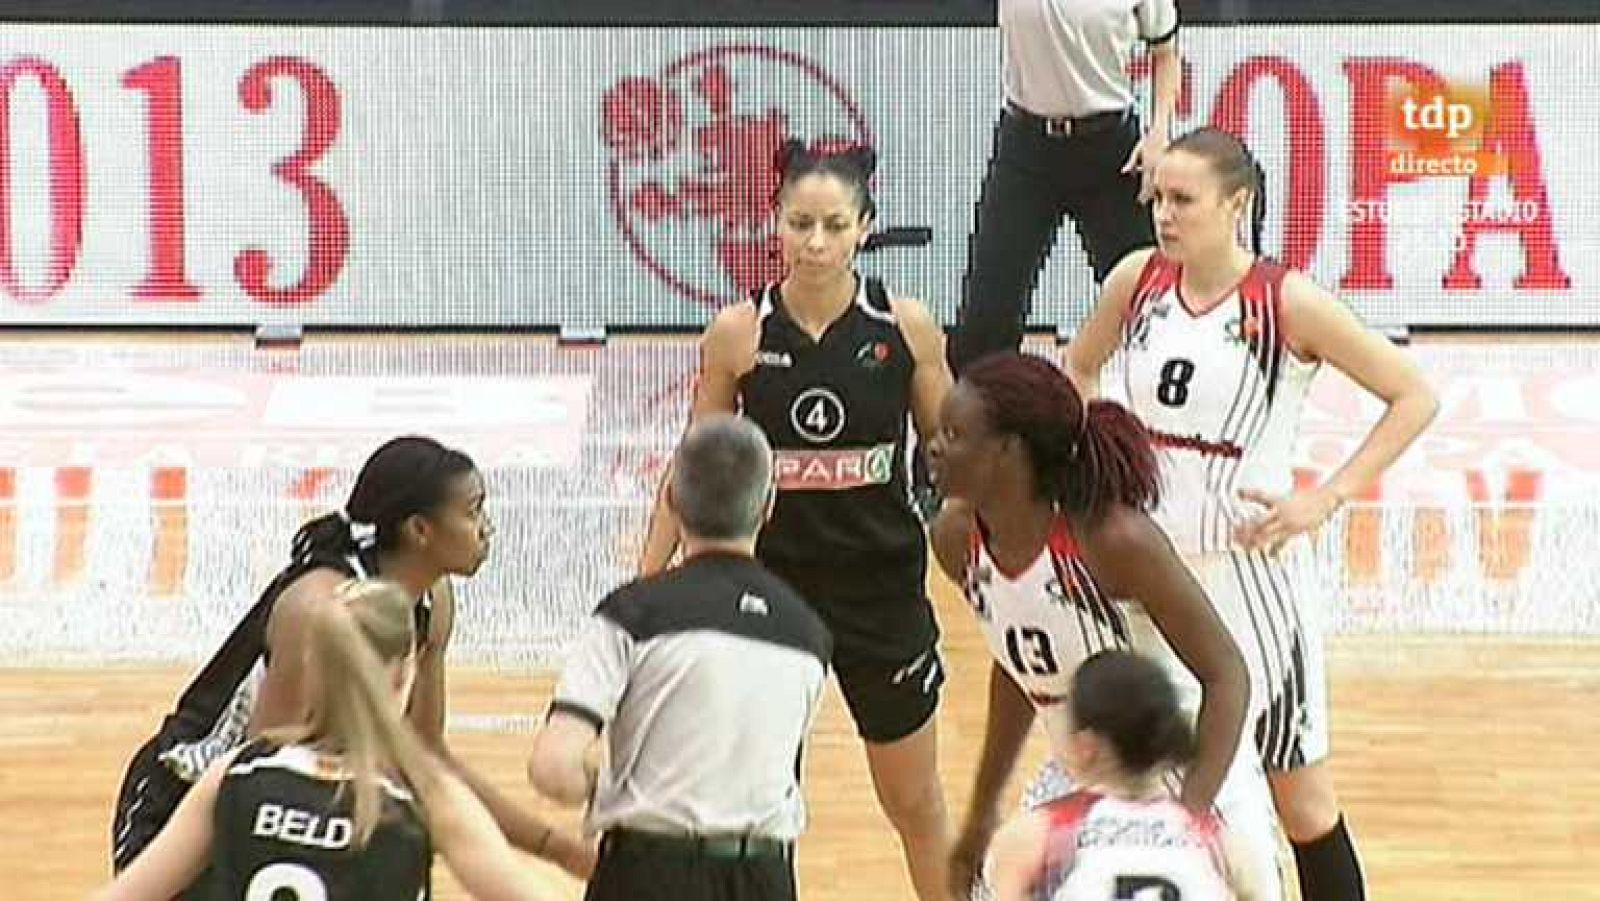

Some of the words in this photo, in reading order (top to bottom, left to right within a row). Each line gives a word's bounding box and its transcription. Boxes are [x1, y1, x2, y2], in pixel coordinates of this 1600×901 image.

[1157, 359, 1195, 408] 8
[805, 398, 828, 432] 4
[1005, 626, 1058, 674] 13
[253, 803, 352, 850] BELD
